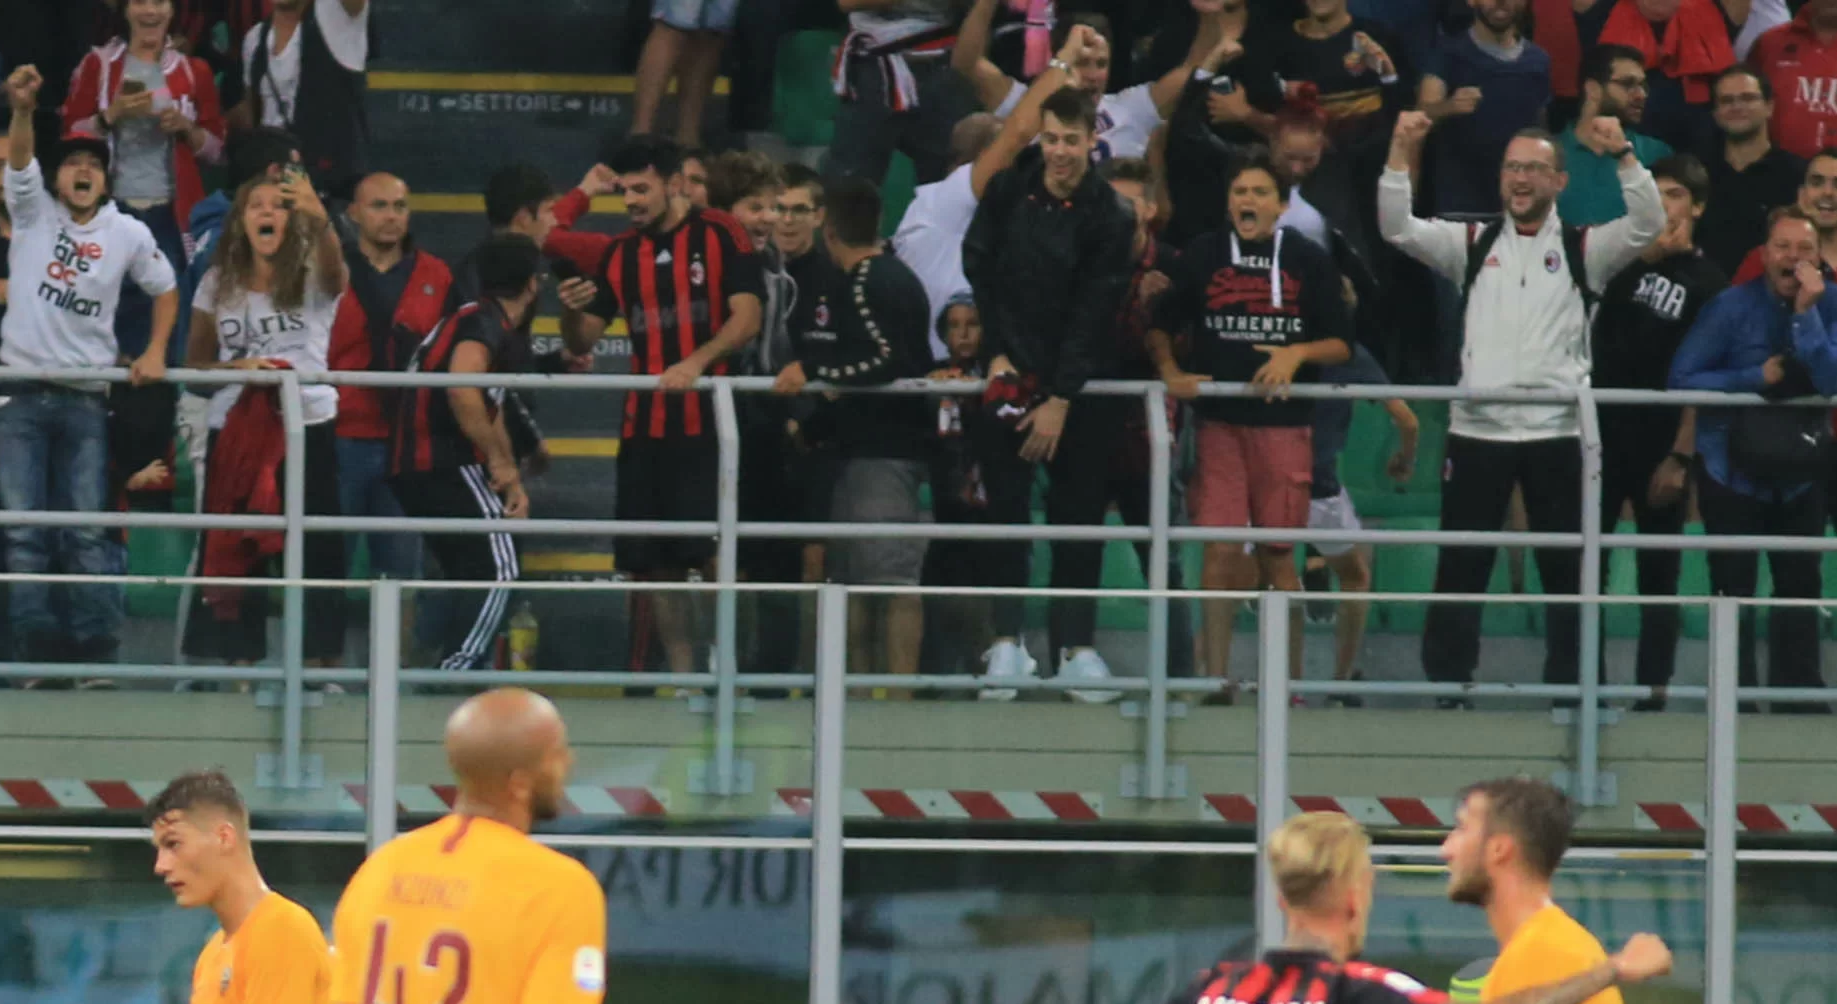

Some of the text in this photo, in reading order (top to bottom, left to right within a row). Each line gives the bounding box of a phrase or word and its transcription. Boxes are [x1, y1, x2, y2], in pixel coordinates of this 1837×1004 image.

[458, 93, 564, 113] SETTORE
[54, 244, 90, 272] are
[47, 261, 79, 288] ac
[37, 280, 102, 318] milan
[1204, 315, 1302, 332] AUTHENTIC
[531, 336, 633, 355] SEOR
